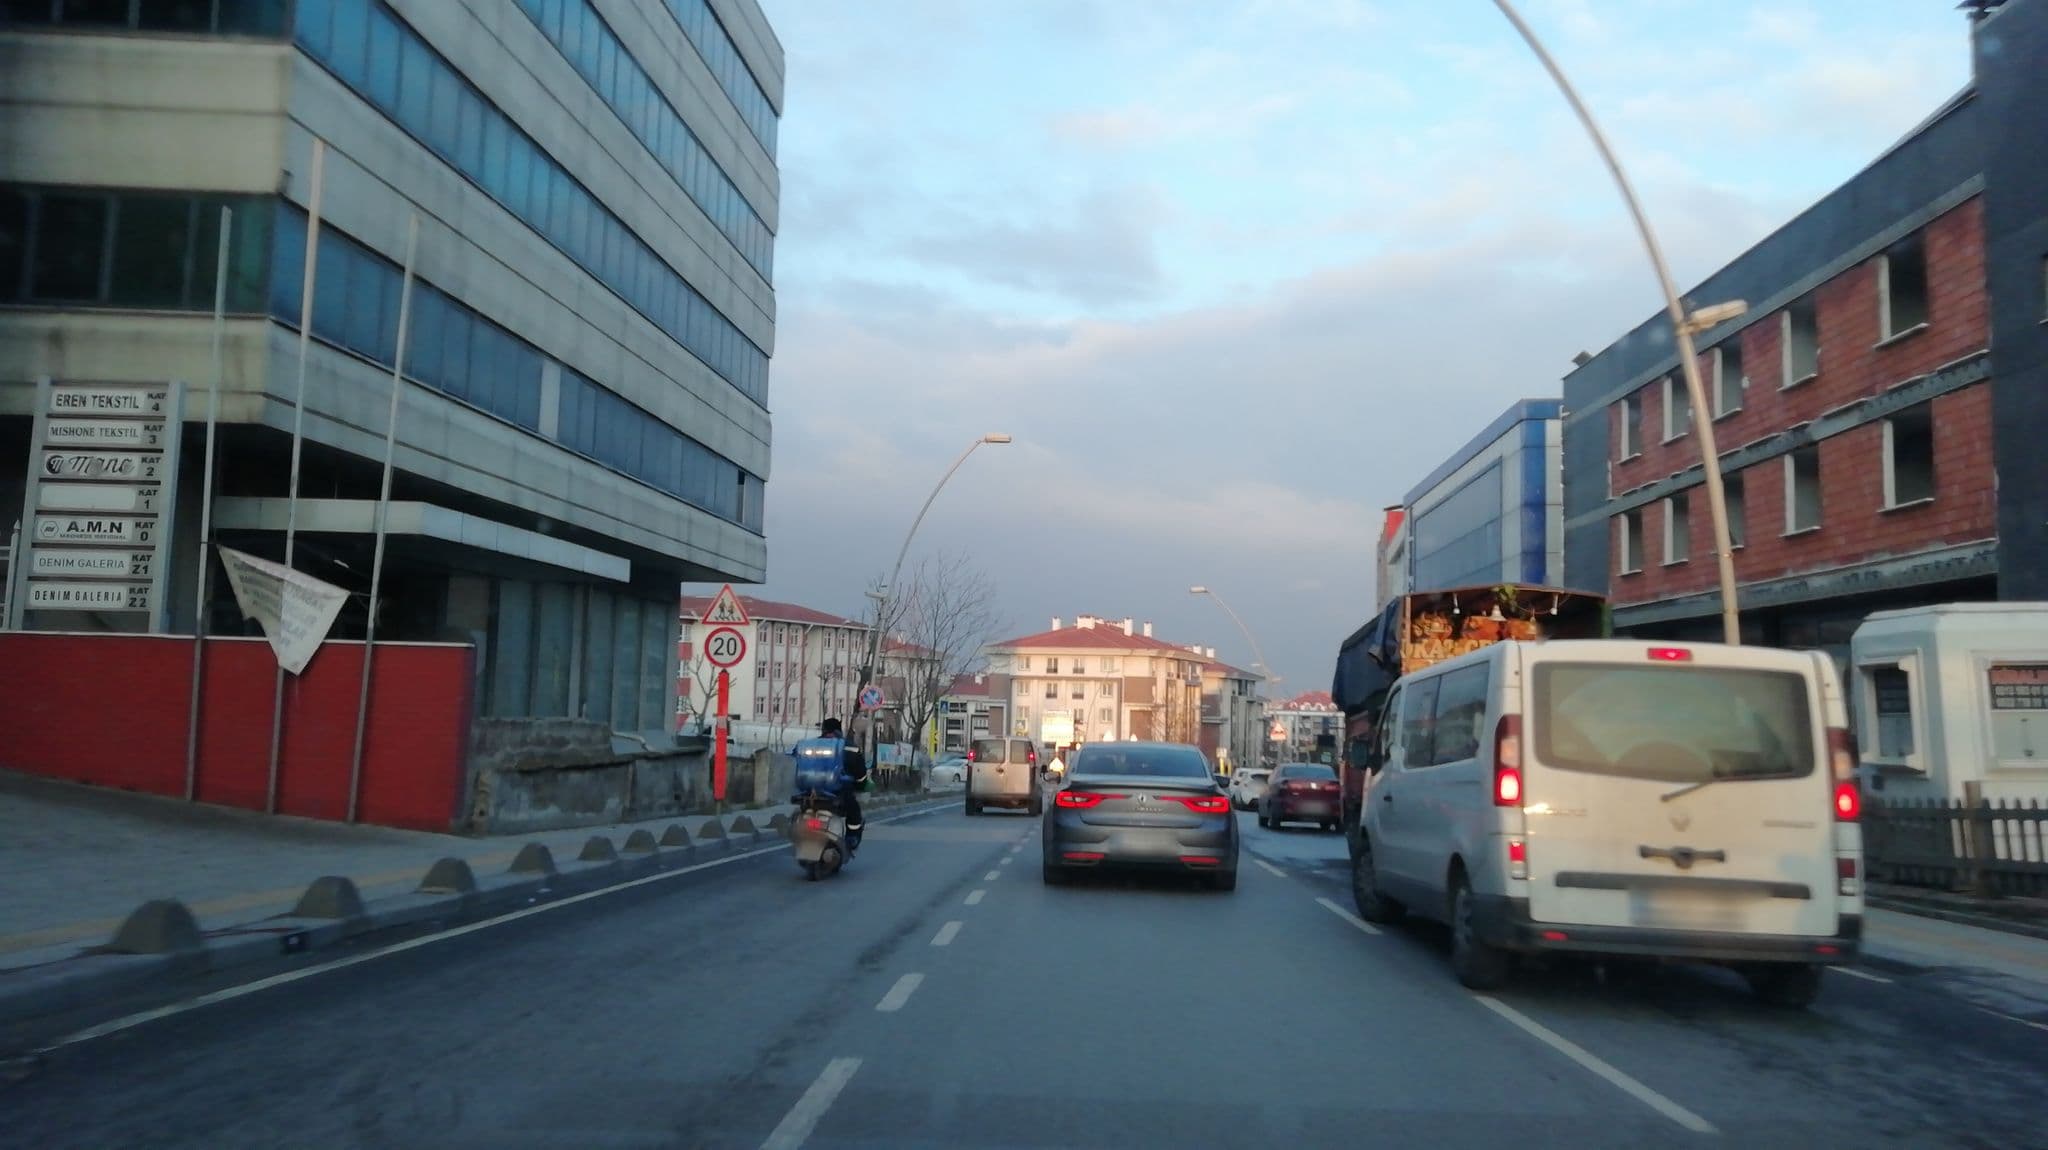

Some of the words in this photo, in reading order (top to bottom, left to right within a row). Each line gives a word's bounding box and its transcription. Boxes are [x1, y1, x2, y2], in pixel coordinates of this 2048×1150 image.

[56, 394, 87, 409] EREN
[147, 392, 167, 401] KAT
[151, 402, 160, 412] 4
[143, 424, 164, 434] KAT
[148, 435, 157, 445] 3
[141, 456, 161, 465] KAT
[146, 467, 155, 477] 2
[138, 489, 158, 497] KAT
[144, 500, 150, 510] 1
[66, 521, 123, 534] A.M.N
[135, 521, 155, 530] KAT
[140, 531, 149, 542] 0
[131, 554, 153, 563] KAT
[78, 559, 125, 569] GALERIA
[132, 565, 149, 575] Z1
[34, 590, 72, 601] DENIM
[75, 591, 122, 602] GALERIA
[128, 587, 149, 596] KAT
[128, 598, 147, 608] Z2
[714, 637, 737, 656] 20
